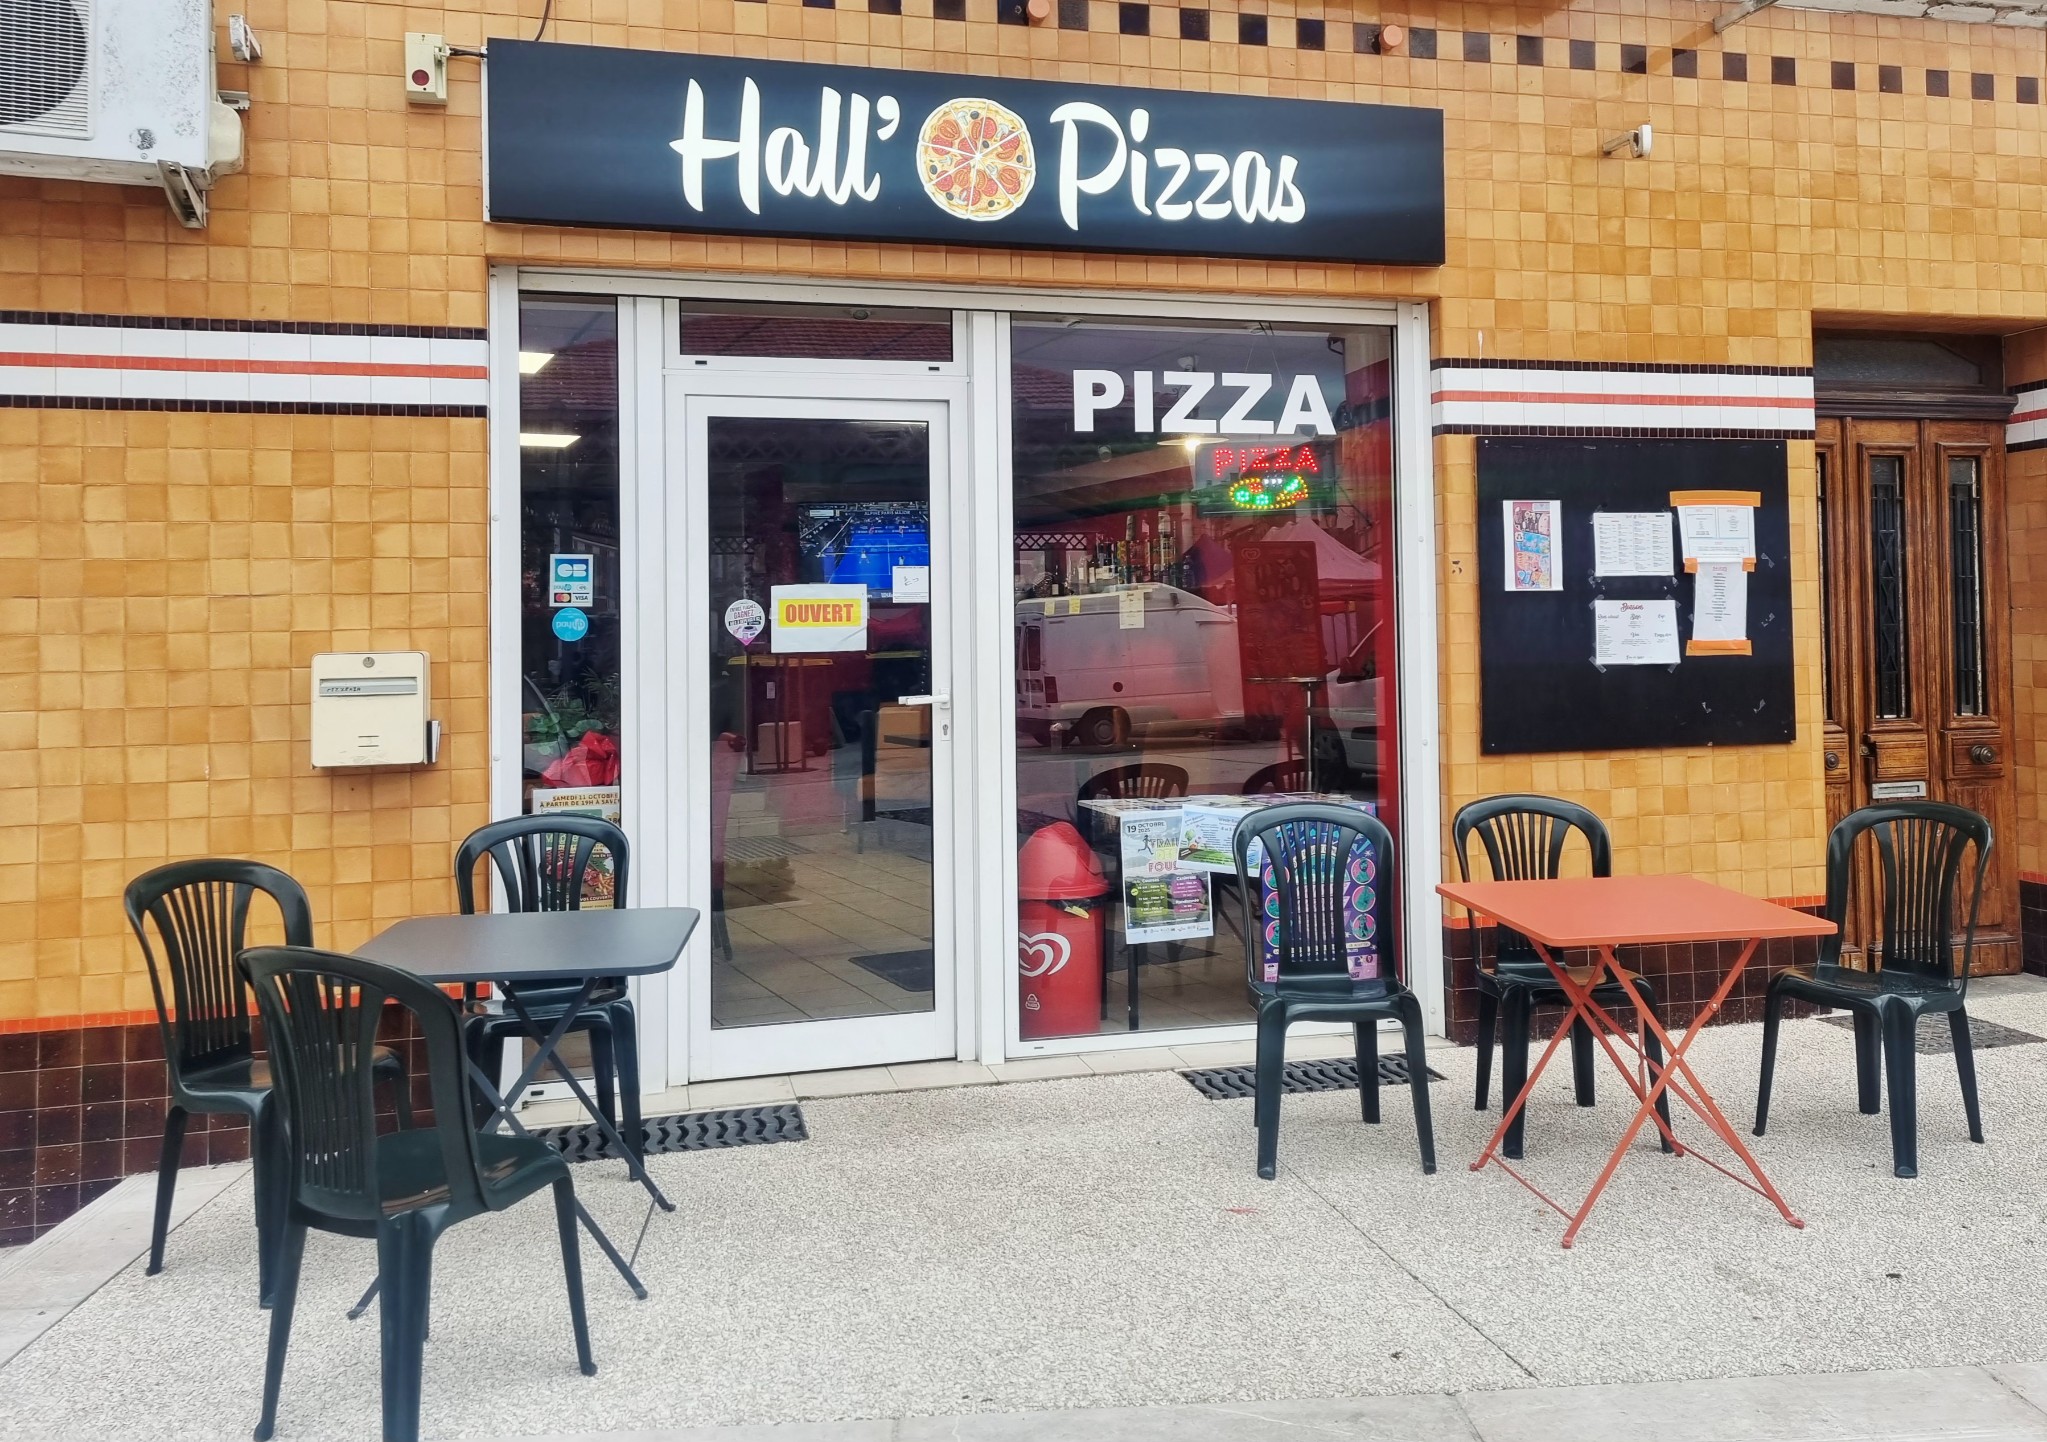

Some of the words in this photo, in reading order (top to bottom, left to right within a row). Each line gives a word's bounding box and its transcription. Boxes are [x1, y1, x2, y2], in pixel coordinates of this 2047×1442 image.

[670, 77, 900, 214] Hall'
[1050, 102, 1306, 230] Pizzas
[1073, 369, 1337, 436] PIZZA
[1213, 446, 1319, 477] PIZZA
[557, 563, 588, 578] CB
[733, 609, 755, 619] GAGNEZ
[785, 603, 854, 624] OUVERT
[552, 794, 578, 802] SAMEDI
[1126, 825, 1137, 834] 19
[1138, 821, 1165, 829] OCTOBRE
